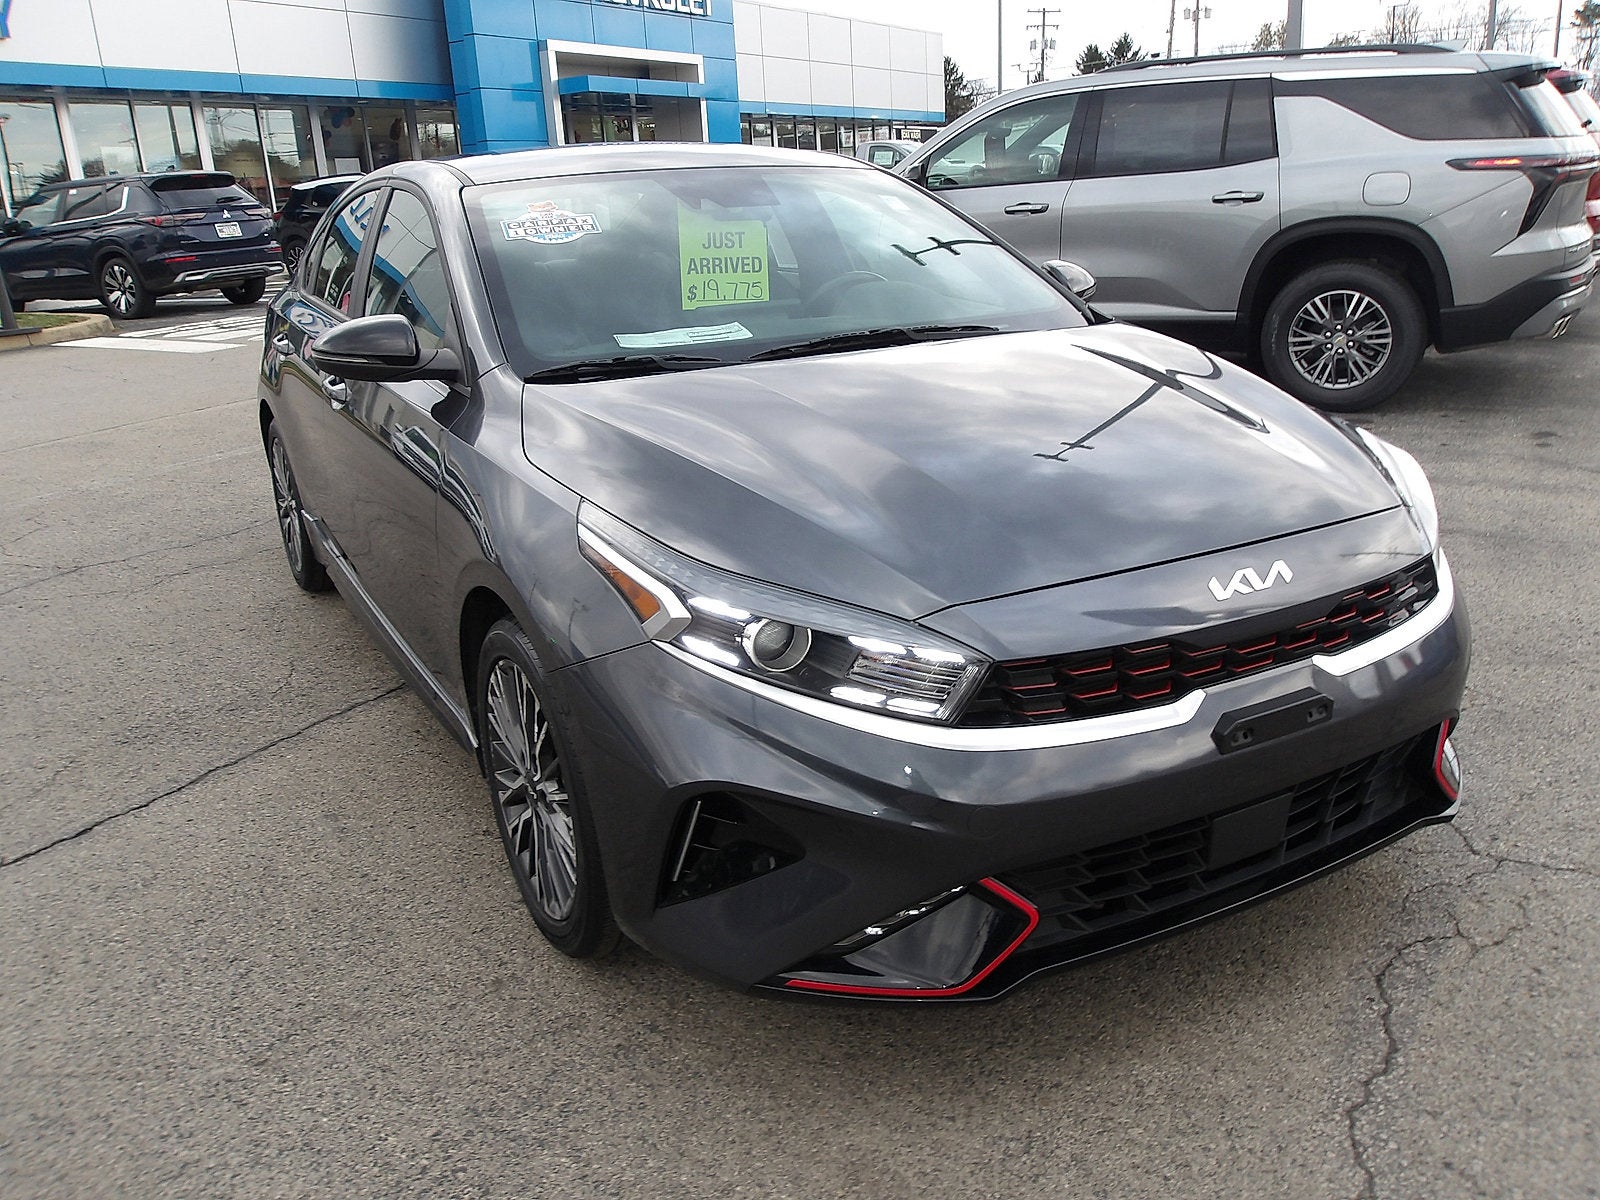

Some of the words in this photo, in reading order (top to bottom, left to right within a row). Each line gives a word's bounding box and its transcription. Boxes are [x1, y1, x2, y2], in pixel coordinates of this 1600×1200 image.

[508, 217, 588, 229] CARFAX
[524, 223, 596, 235] OWNER
[702, 231, 745, 249] JUST
[687, 256, 763, 275] ARRIVED
[1207, 559, 1294, 602] KIA
